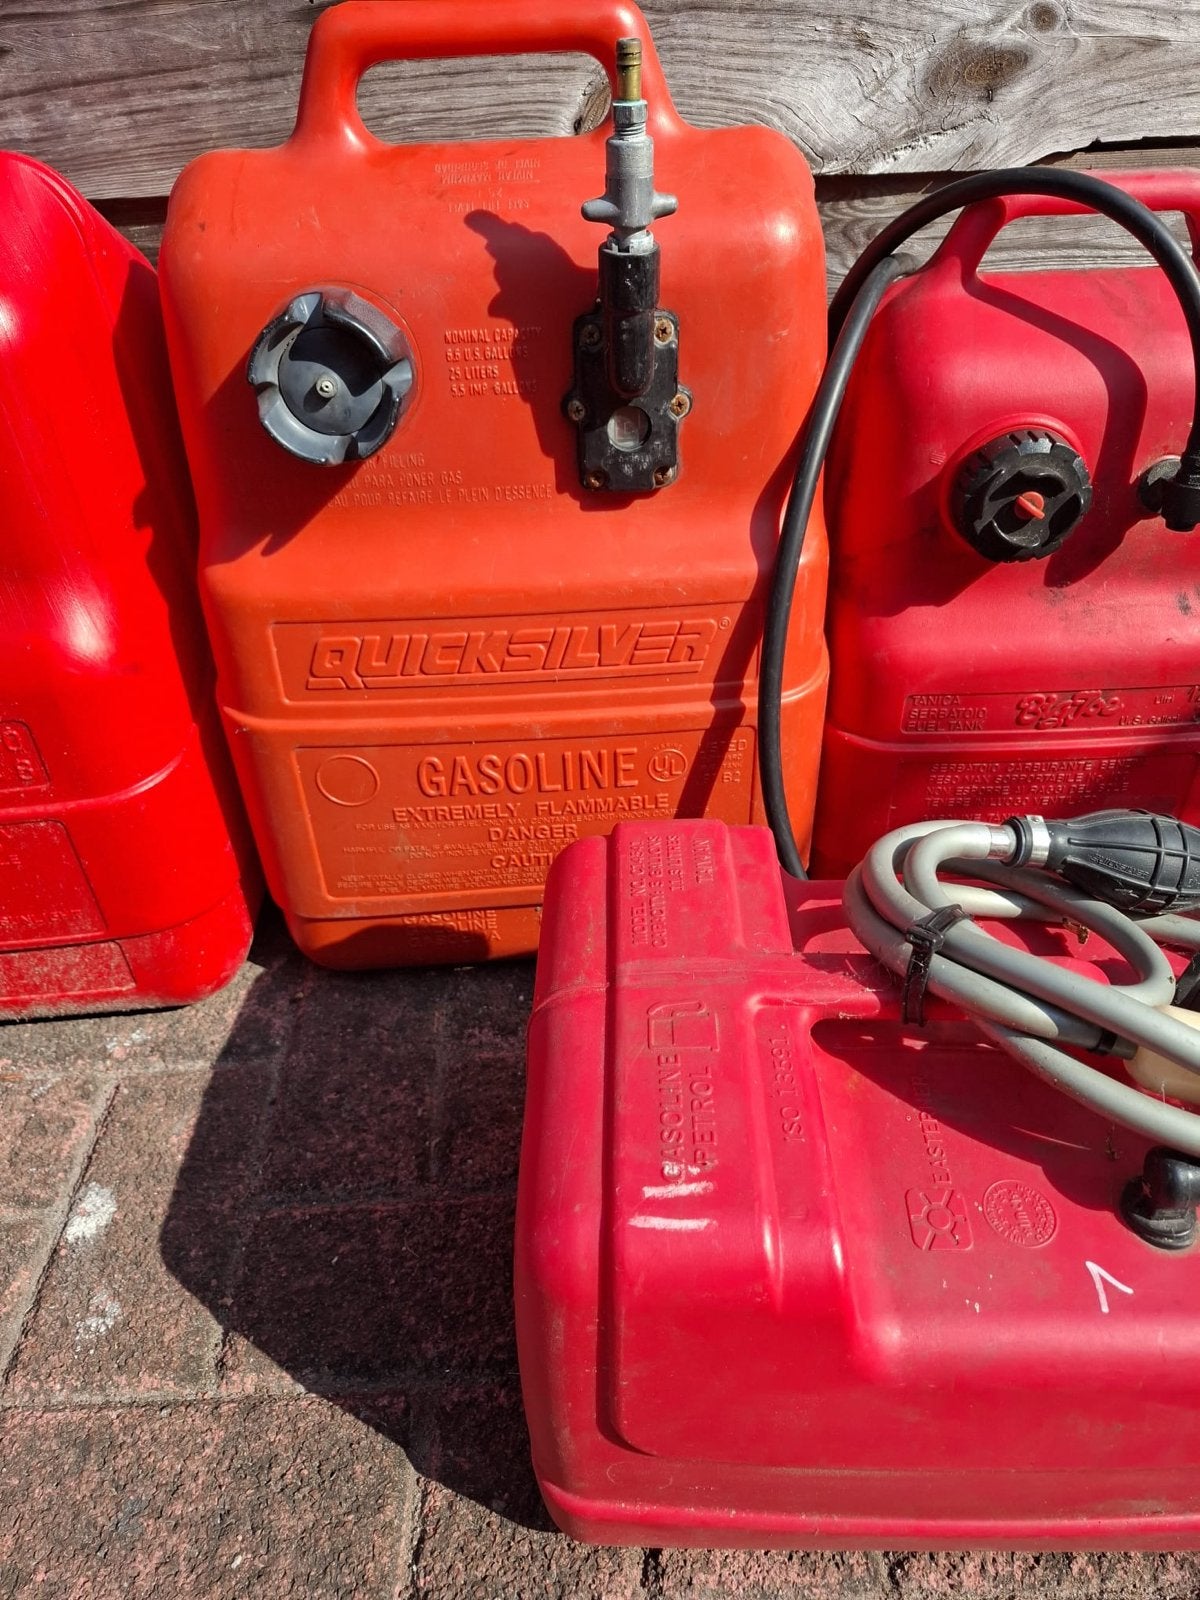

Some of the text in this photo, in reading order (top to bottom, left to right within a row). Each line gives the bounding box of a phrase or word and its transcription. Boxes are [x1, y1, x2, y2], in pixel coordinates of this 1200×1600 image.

[445, 328, 490, 344] NOMINAL
[449, 364, 499, 381] 25 LITERS
[383, 452, 425, 469] FILLING
[364, 472, 394, 488] PARA
[399, 471, 434, 487] PONER
[441, 470, 464, 486] GAS
[354, 492, 382, 507] POUR
[439, 490, 452, 505] LE
[458, 488, 490, 504] PLEIN
[494, 483, 552, 502] D'ESSENCE
[306, 619, 716, 690] QUICKSILVER
[912, 695, 961, 706] TANICA
[907, 719, 985, 732] FUEL TANK
[417, 746, 639, 798] GASOLINE
[393, 792, 670, 822] EXTREMELY FLAMMABLE
[489, 823, 578, 841] DANGER
[491, 853, 554, 868] CAUTI
[631, 902, 648, 945] MODEL
[768, 1037, 797, 1097] 13591
[657, 1054, 686, 1184] GASOLINE
[688, 1066, 718, 1166] PETROL
